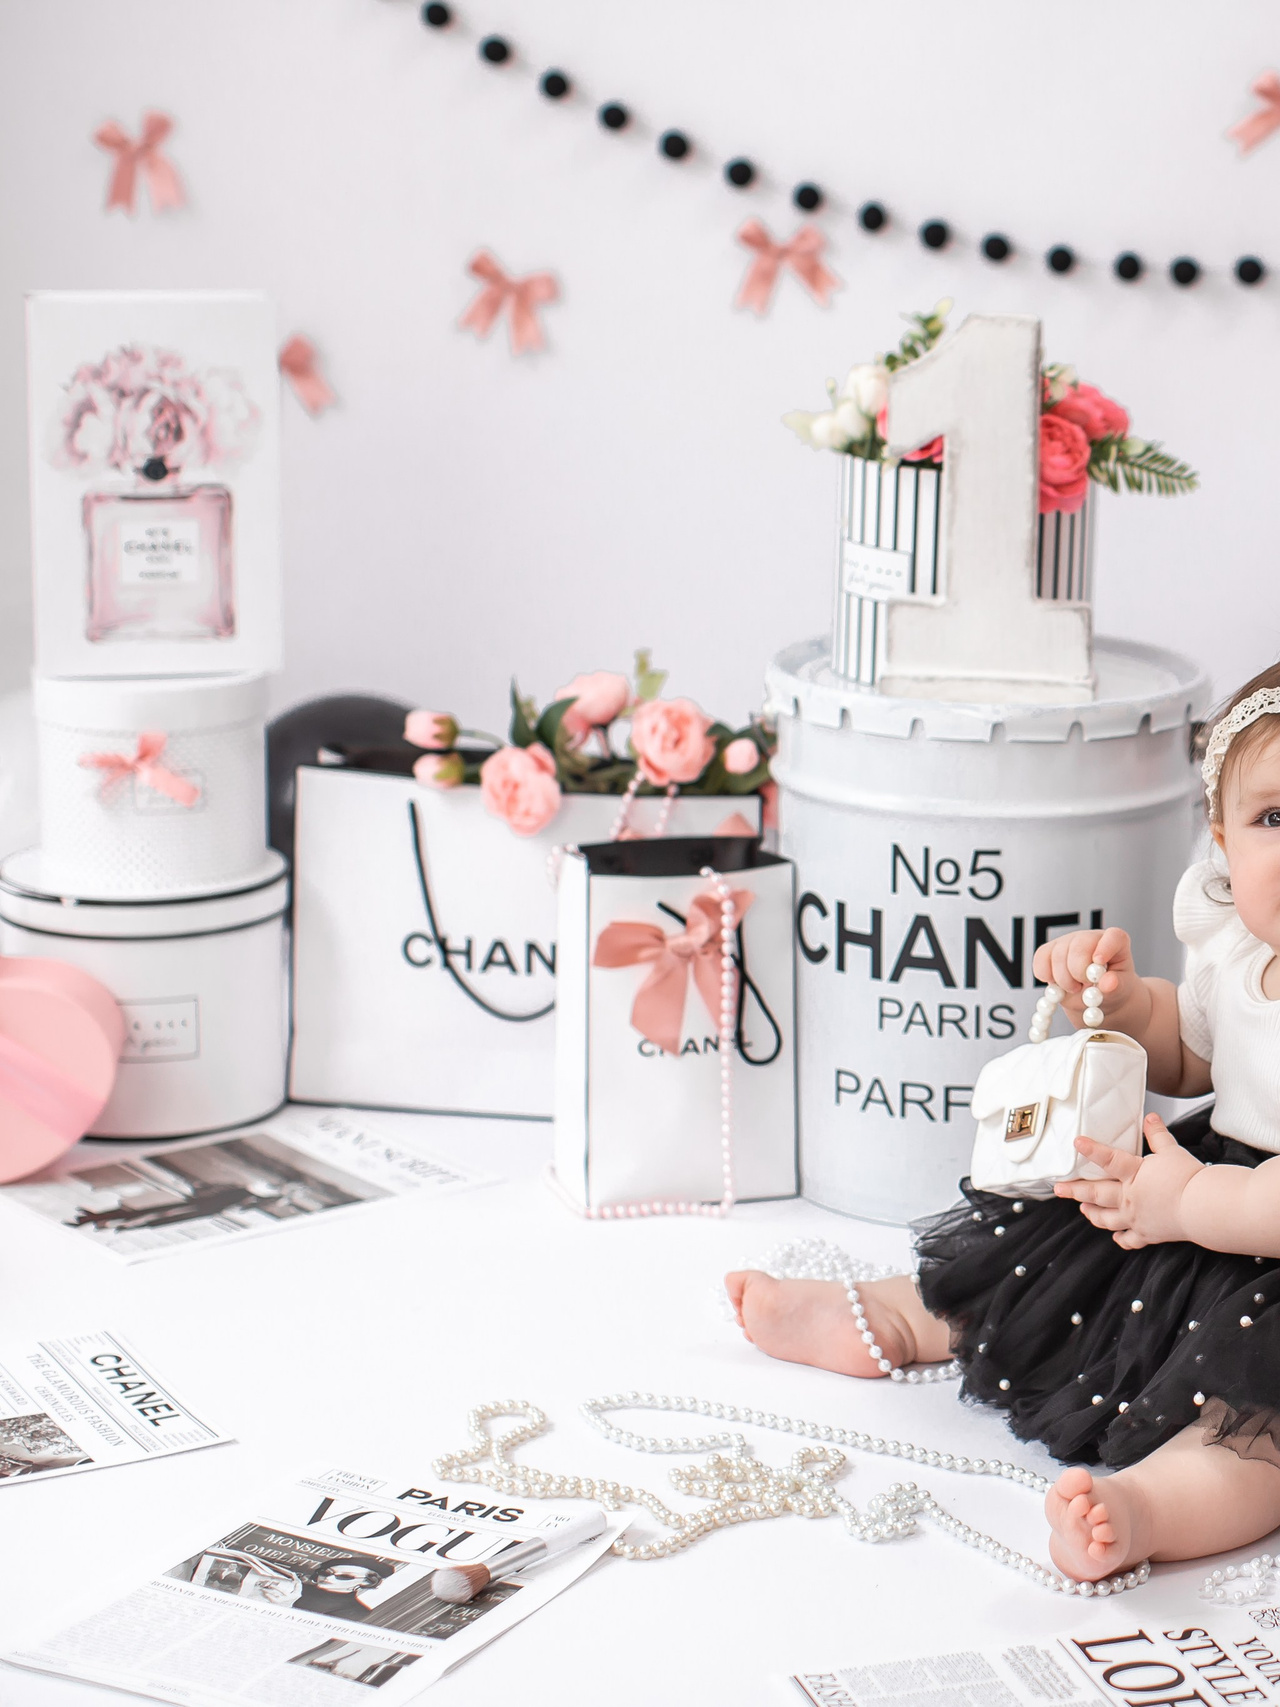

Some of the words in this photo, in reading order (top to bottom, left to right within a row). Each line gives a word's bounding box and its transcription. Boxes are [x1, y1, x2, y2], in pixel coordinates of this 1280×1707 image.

[797, 891, 1105, 989] CHANE
[877, 997, 1017, 1040] PARIS
[26, 1353, 50, 1370] THE
[41, 1370, 94, 1415] GLAMOROUS
[84, 1408, 126, 1448] FASHION
[34, 1385, 76, 1423] CHRONICLES
[90, 1353, 181, 1428] CHANEL
[327, 1476, 371, 1490] FASHION
[336, 1471, 379, 1486] FRENCH
[396, 1487, 525, 1523] PARIS
[1162, 1627, 1268, 1705] STYLE
